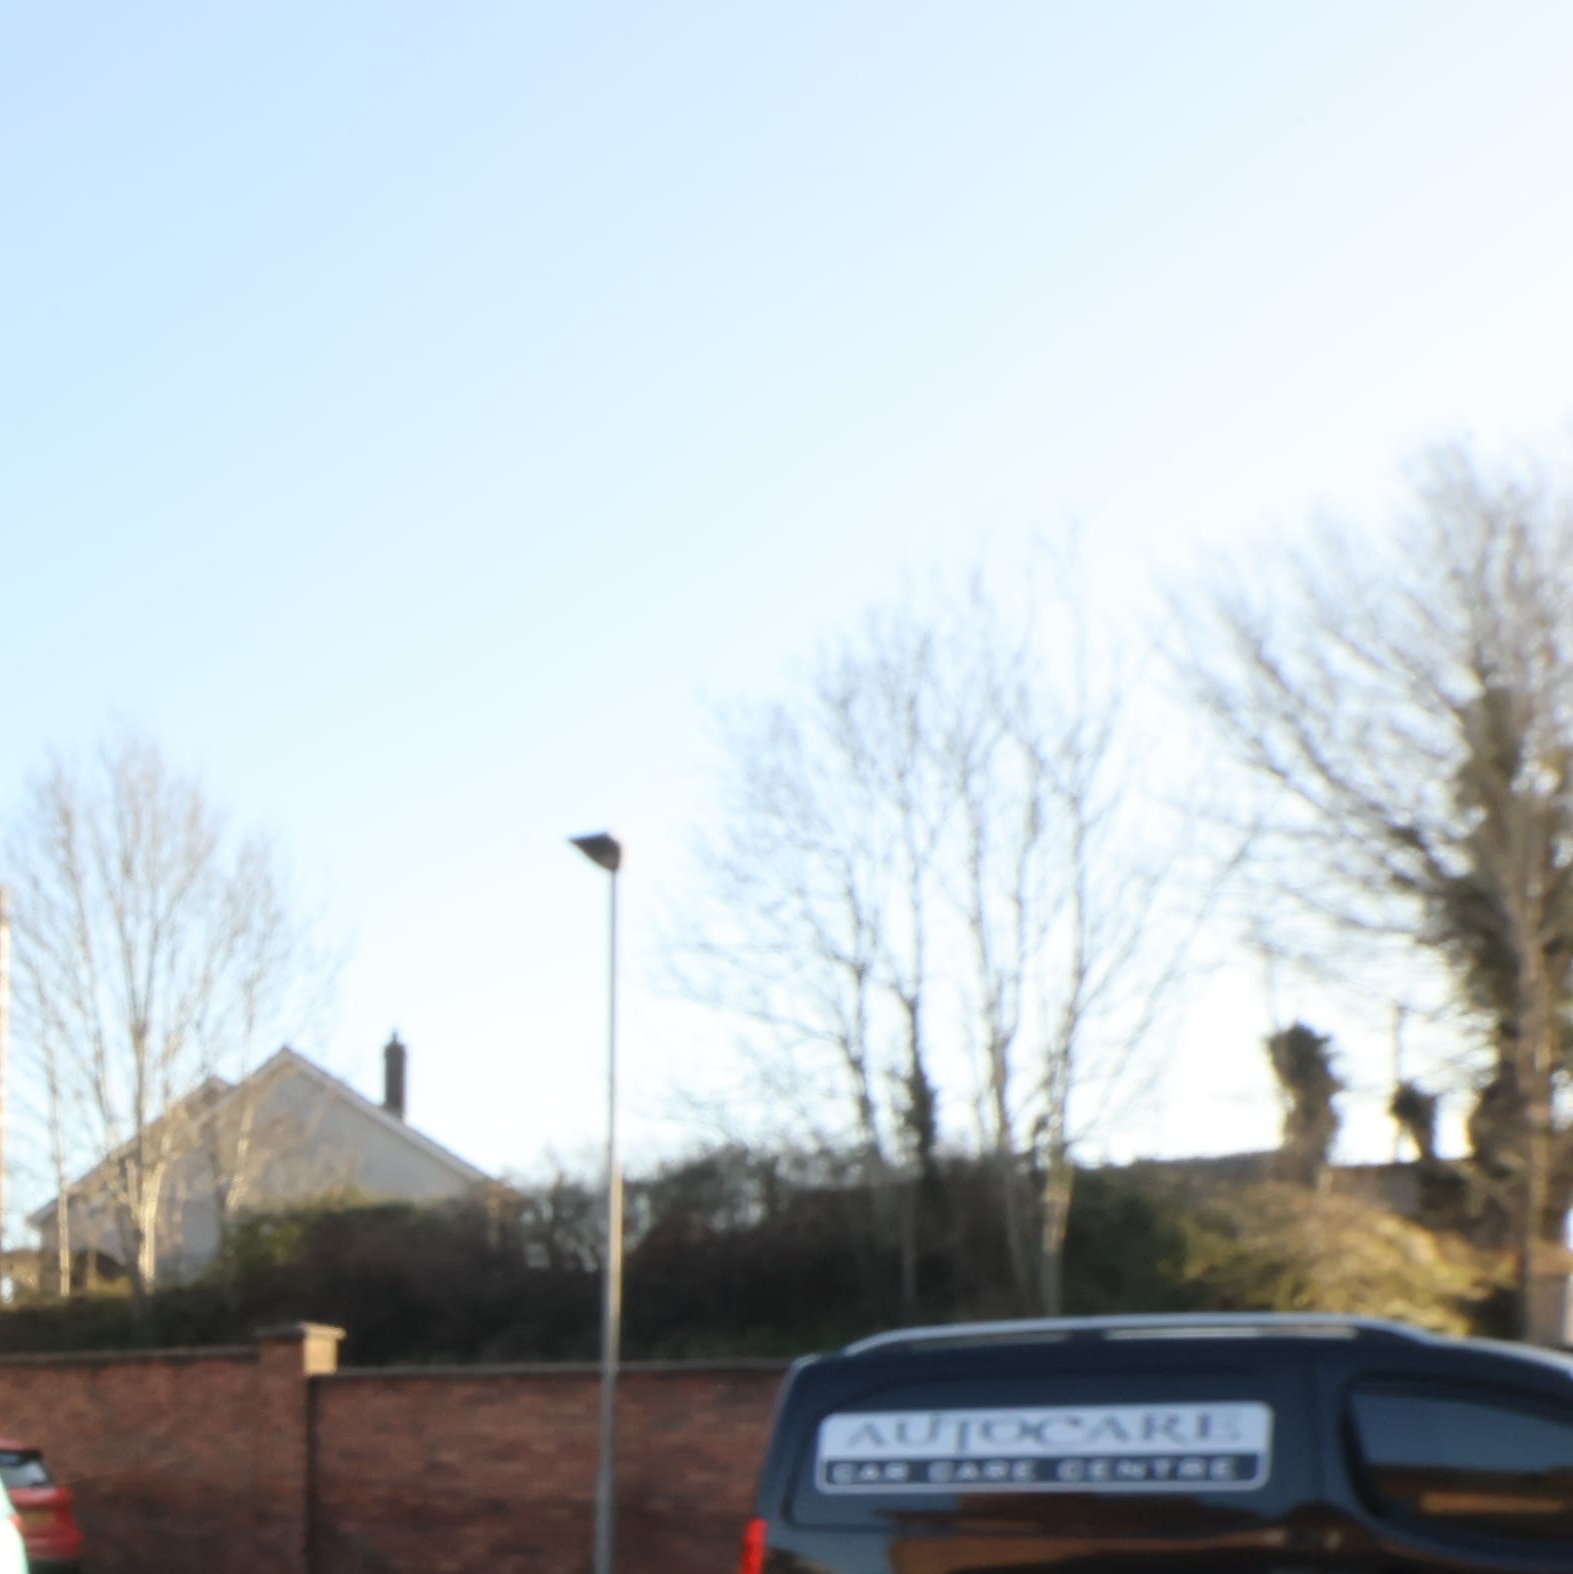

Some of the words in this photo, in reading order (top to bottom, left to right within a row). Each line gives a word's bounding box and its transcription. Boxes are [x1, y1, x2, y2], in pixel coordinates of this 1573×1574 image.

[846, 1409, 1245, 1453] AUTOCARE
[831, 1460, 911, 1485] CAR
[926, 1458, 1040, 1483] CARE
[1056, 1453, 1239, 1482] CENTRE
